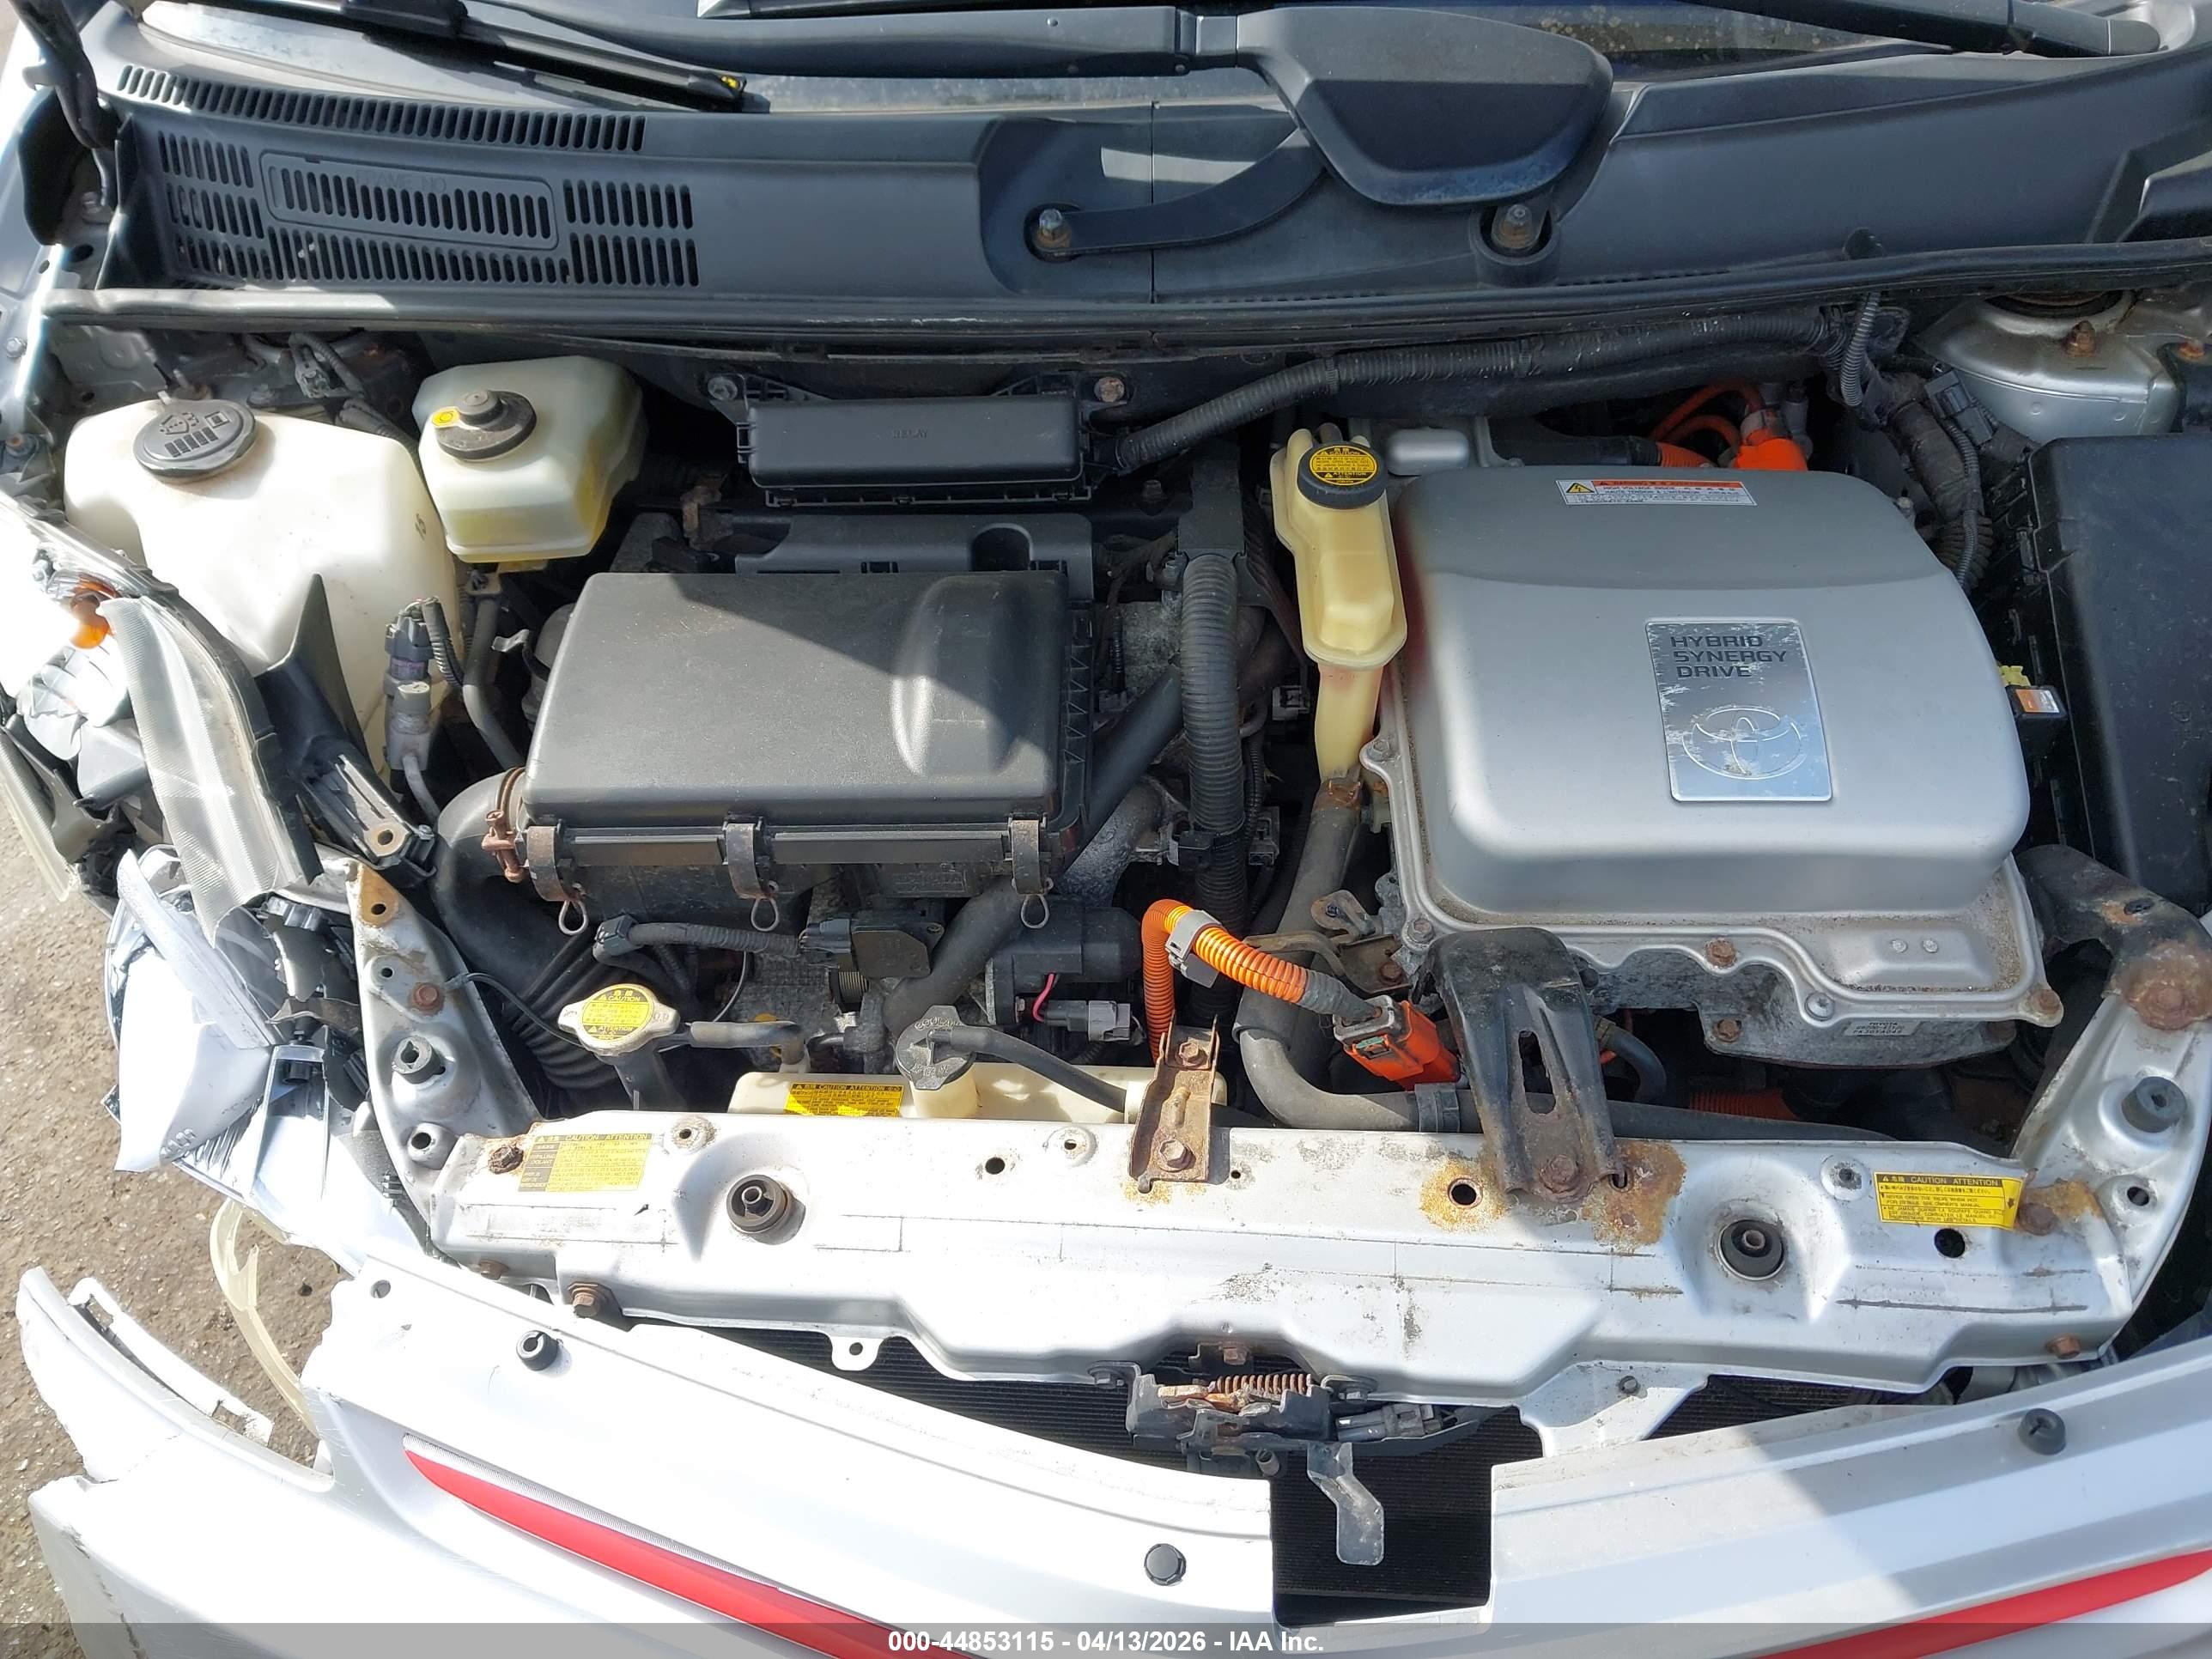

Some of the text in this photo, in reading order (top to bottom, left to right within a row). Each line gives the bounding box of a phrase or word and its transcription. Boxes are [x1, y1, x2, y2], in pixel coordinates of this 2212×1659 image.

[893, 429, 927, 439] RELAY
[1670, 635, 1763, 647] HYBRID
[1674, 650, 1787, 662] SYNERGY
[1676, 665, 1752, 677] DRIVE
